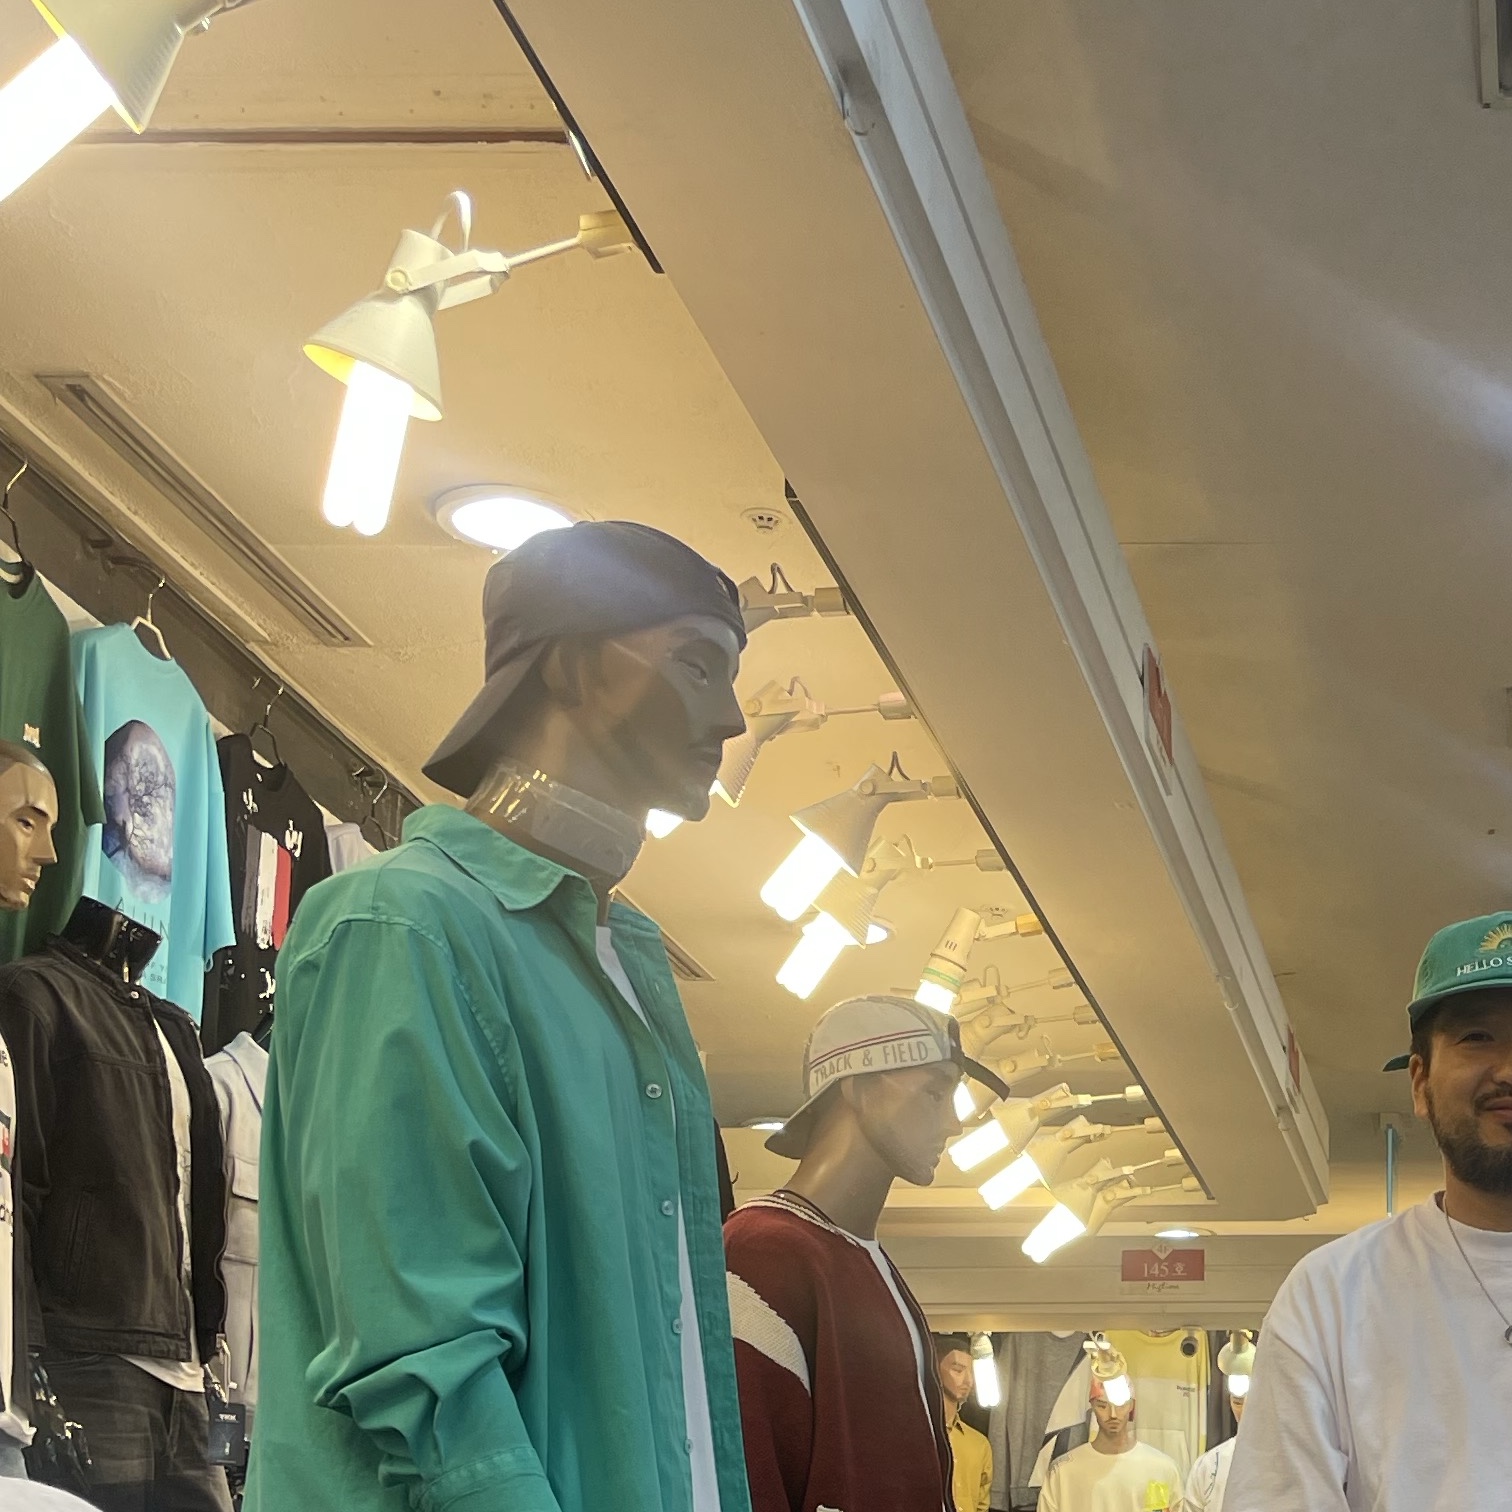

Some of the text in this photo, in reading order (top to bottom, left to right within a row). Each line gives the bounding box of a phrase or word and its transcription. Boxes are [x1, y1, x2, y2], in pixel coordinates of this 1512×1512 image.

[1456, 956, 1503, 976] HELLO
[813, 1040, 929, 1087] TRACK & FIELD
